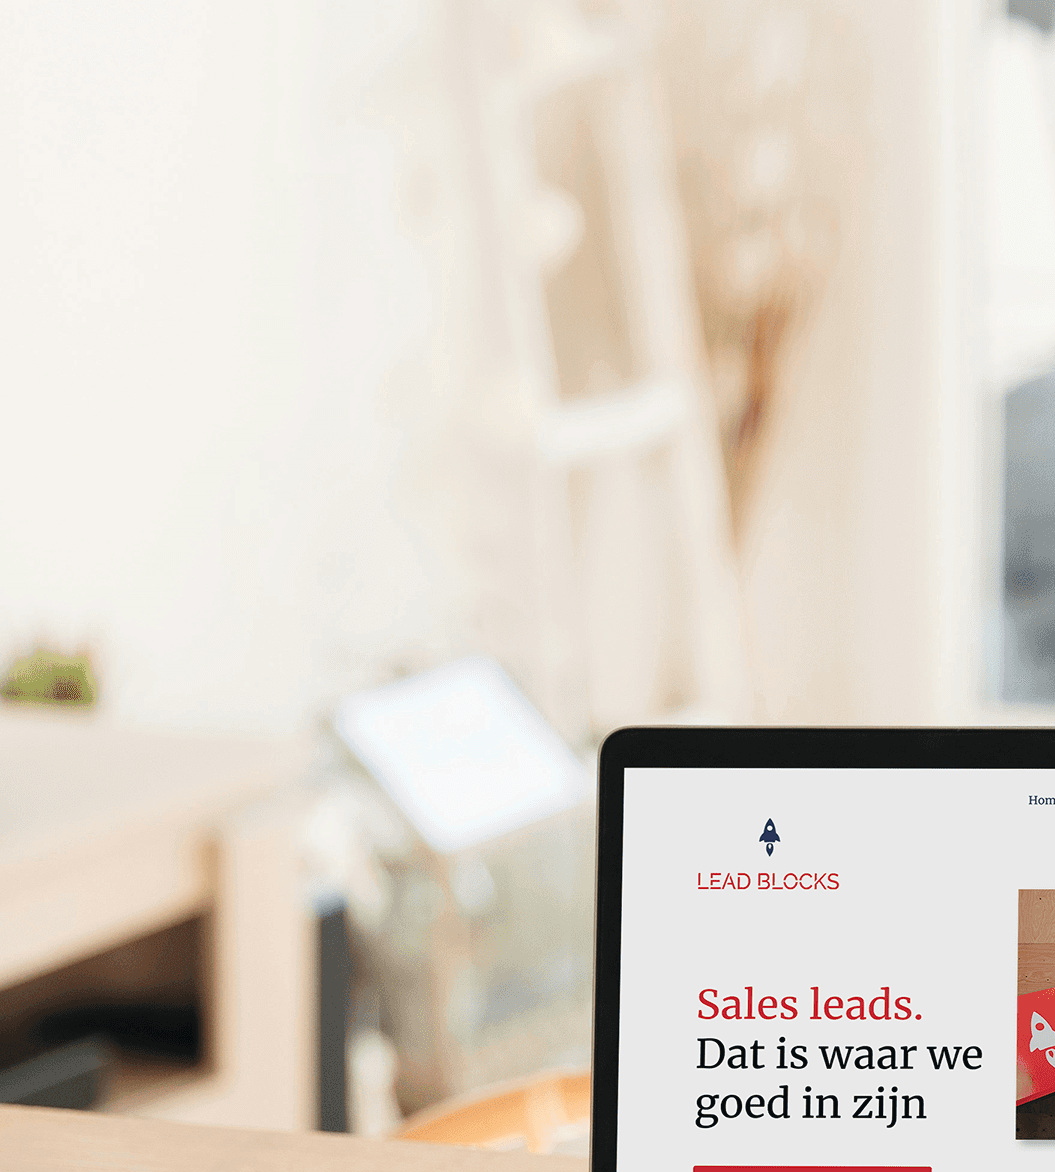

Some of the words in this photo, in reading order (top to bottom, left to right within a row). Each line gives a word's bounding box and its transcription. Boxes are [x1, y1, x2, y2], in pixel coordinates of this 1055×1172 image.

[698, 873, 751, 889] LEAD
[758, 873, 839, 890] BLOCKS
[698, 986, 798, 1020] Sales
[810, 986, 922, 1020] leads.
[696, 1038, 765, 1069] Dat
[776, 1037, 808, 1069] is
[818, 1046, 917, 1069] waar
[926, 1046, 982, 1070] we
[695, 1085, 790, 1128] goed
[802, 1086, 841, 1118] in
[852, 1086, 927, 1128] zijn
